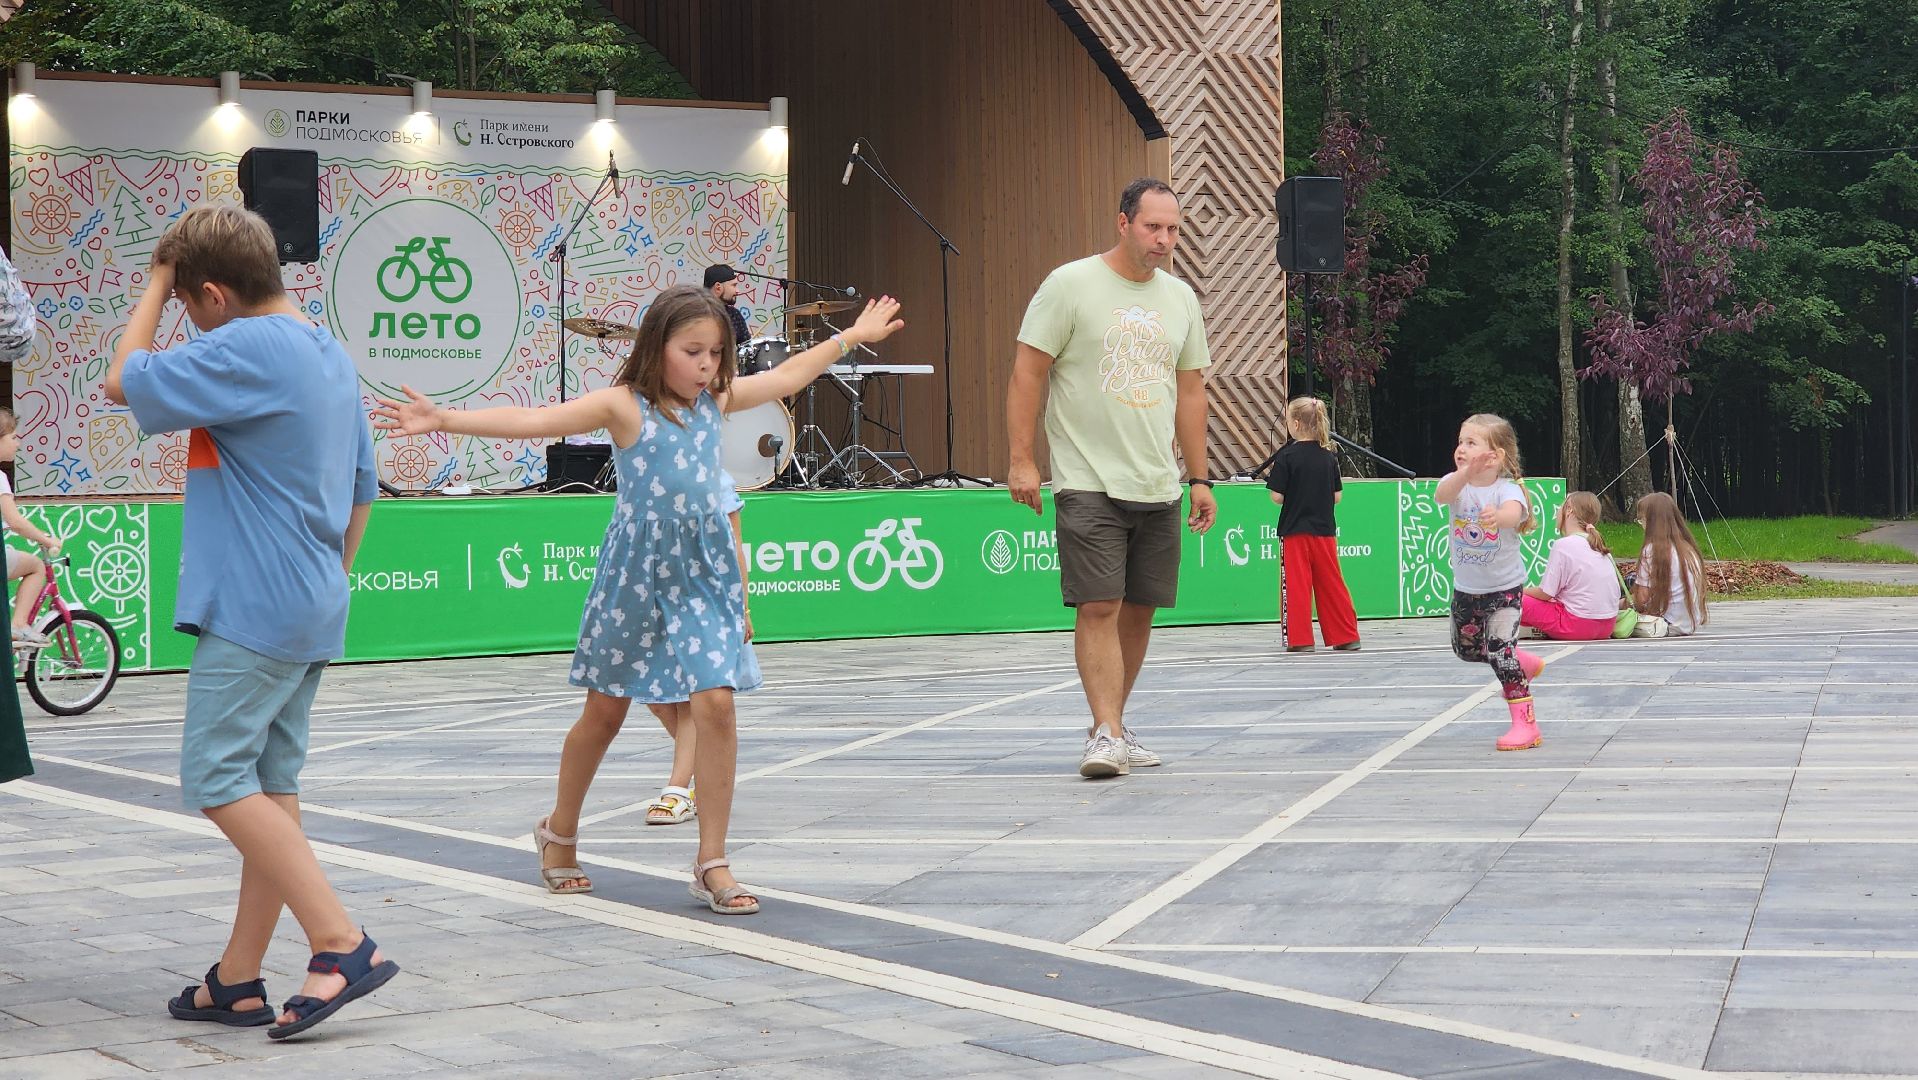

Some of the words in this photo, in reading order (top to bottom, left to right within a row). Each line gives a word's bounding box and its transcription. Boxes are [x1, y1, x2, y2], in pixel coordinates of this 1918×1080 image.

[296, 110, 350, 125] ПАРКИ
[480, 118, 509, 133] Парк
[512, 122, 549, 133] имени
[296, 126, 424, 145] ПОДМОСКОВЬЯ
[480, 133, 494, 145] Н.
[497, 132, 574, 149] Островского
[369, 347, 377, 358] В
[382, 348, 482, 360] ПОДМОСКОВЬЕ
[543, 542, 586, 562] Парк
[1260, 544, 1277, 559] Н.
[543, 564, 564, 581] Н.
[747, 579, 841, 597] ОДМОСКОВЬЕ
